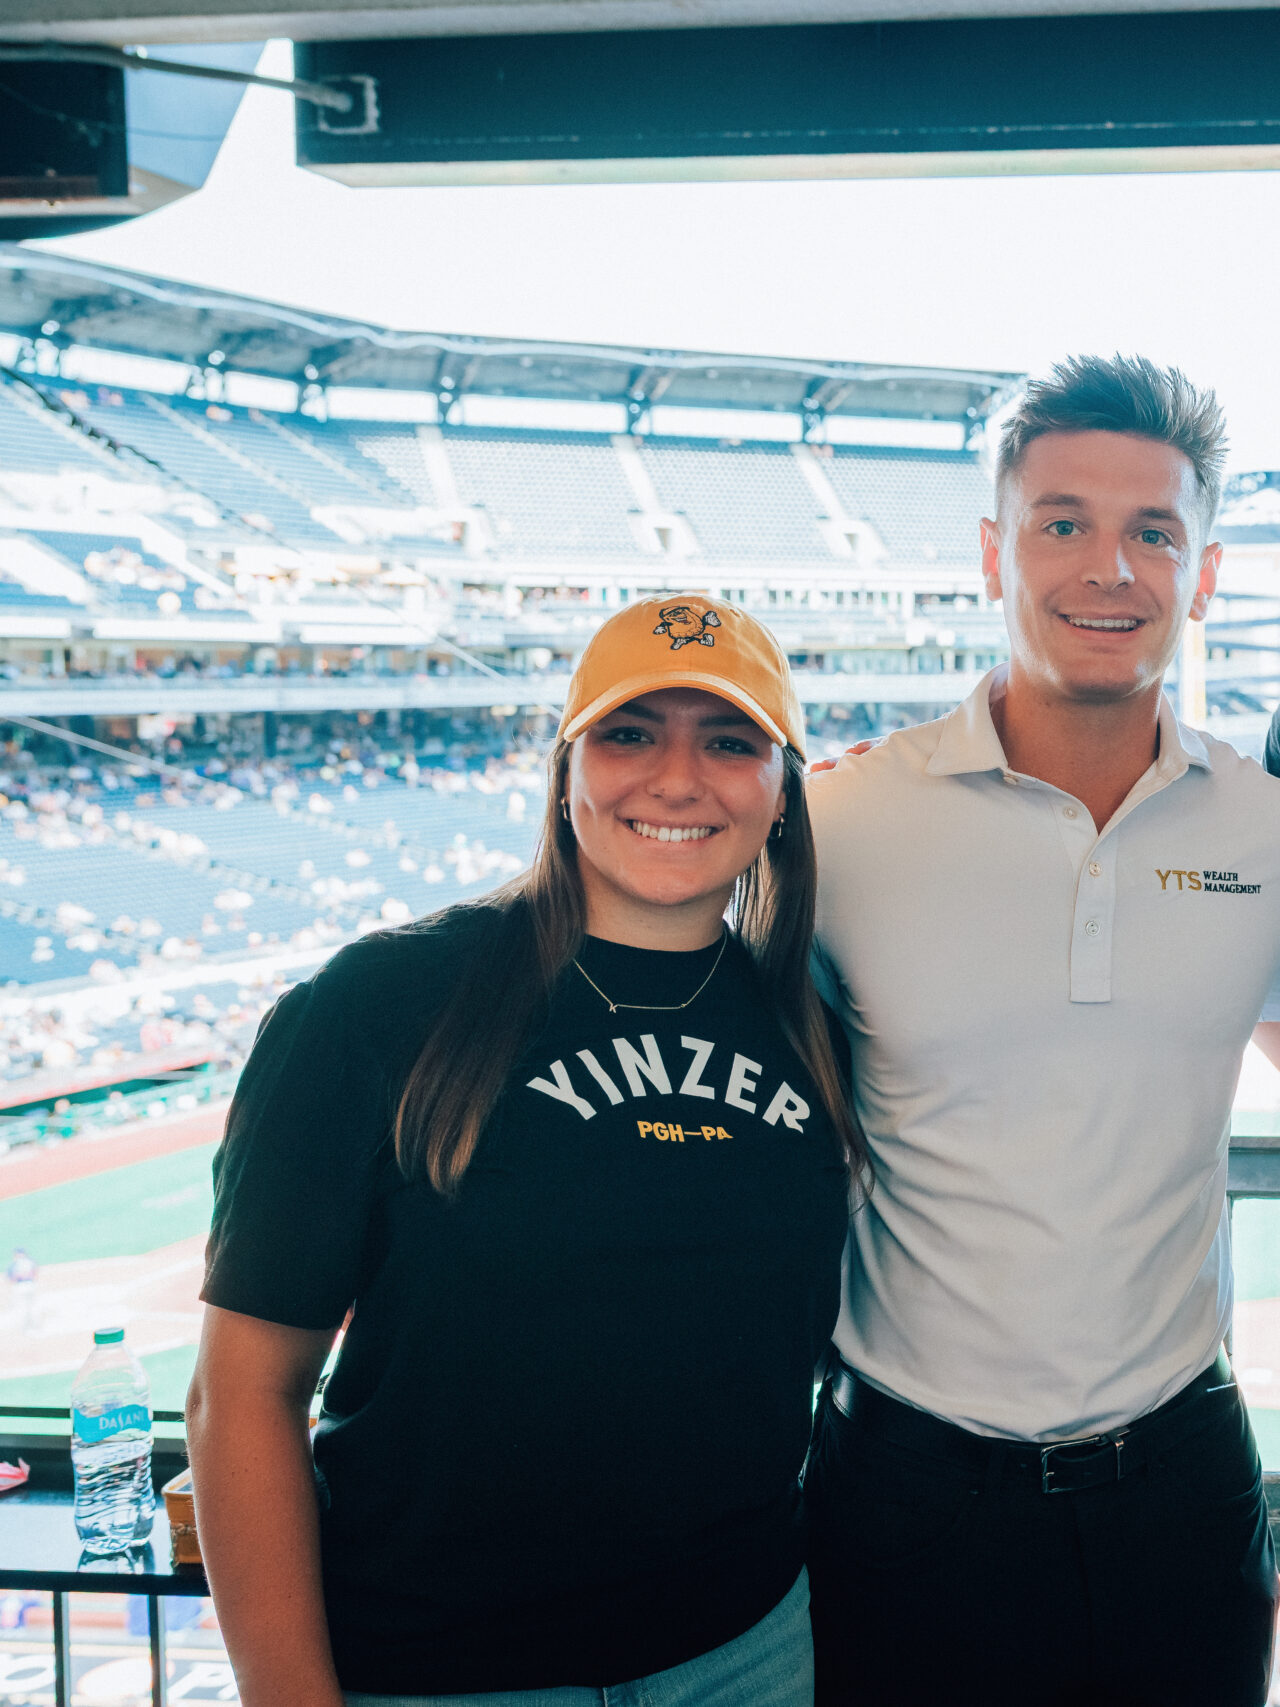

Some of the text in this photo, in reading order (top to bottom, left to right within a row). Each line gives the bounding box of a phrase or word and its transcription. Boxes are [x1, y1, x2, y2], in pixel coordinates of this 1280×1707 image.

[1154, 869, 1202, 891] YTS
[1203, 871, 1239, 882] WEALTH
[1203, 883, 1262, 894] MANAGEMENT
[525, 1034, 811, 1134] YINZER
